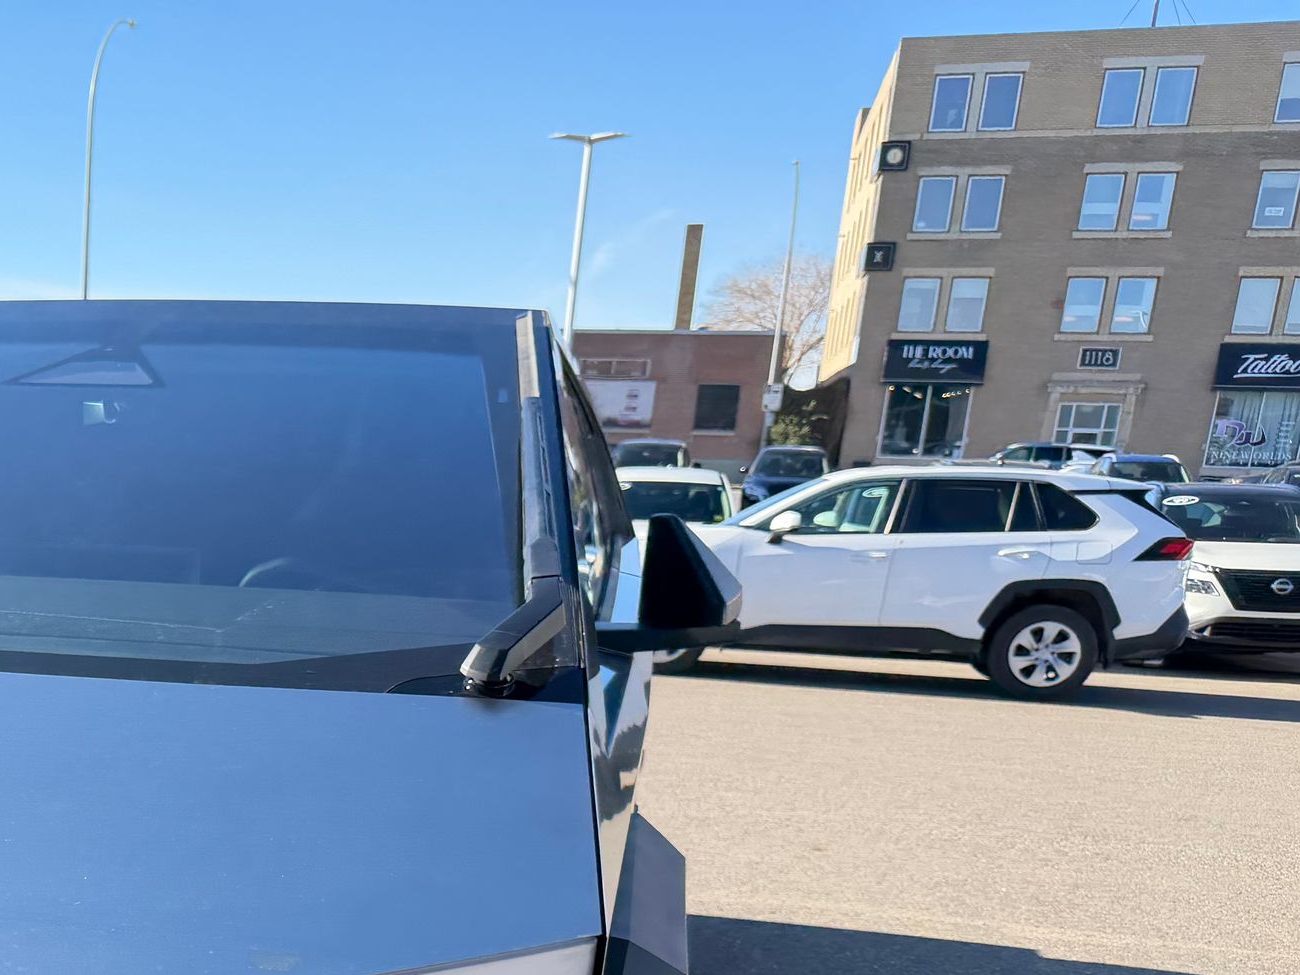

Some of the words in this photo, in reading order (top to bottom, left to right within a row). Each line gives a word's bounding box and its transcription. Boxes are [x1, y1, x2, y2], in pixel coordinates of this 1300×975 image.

[902, 344, 927, 359] THE
[928, 345, 974, 360] ROOM
[1084, 351, 1114, 365] 1118
